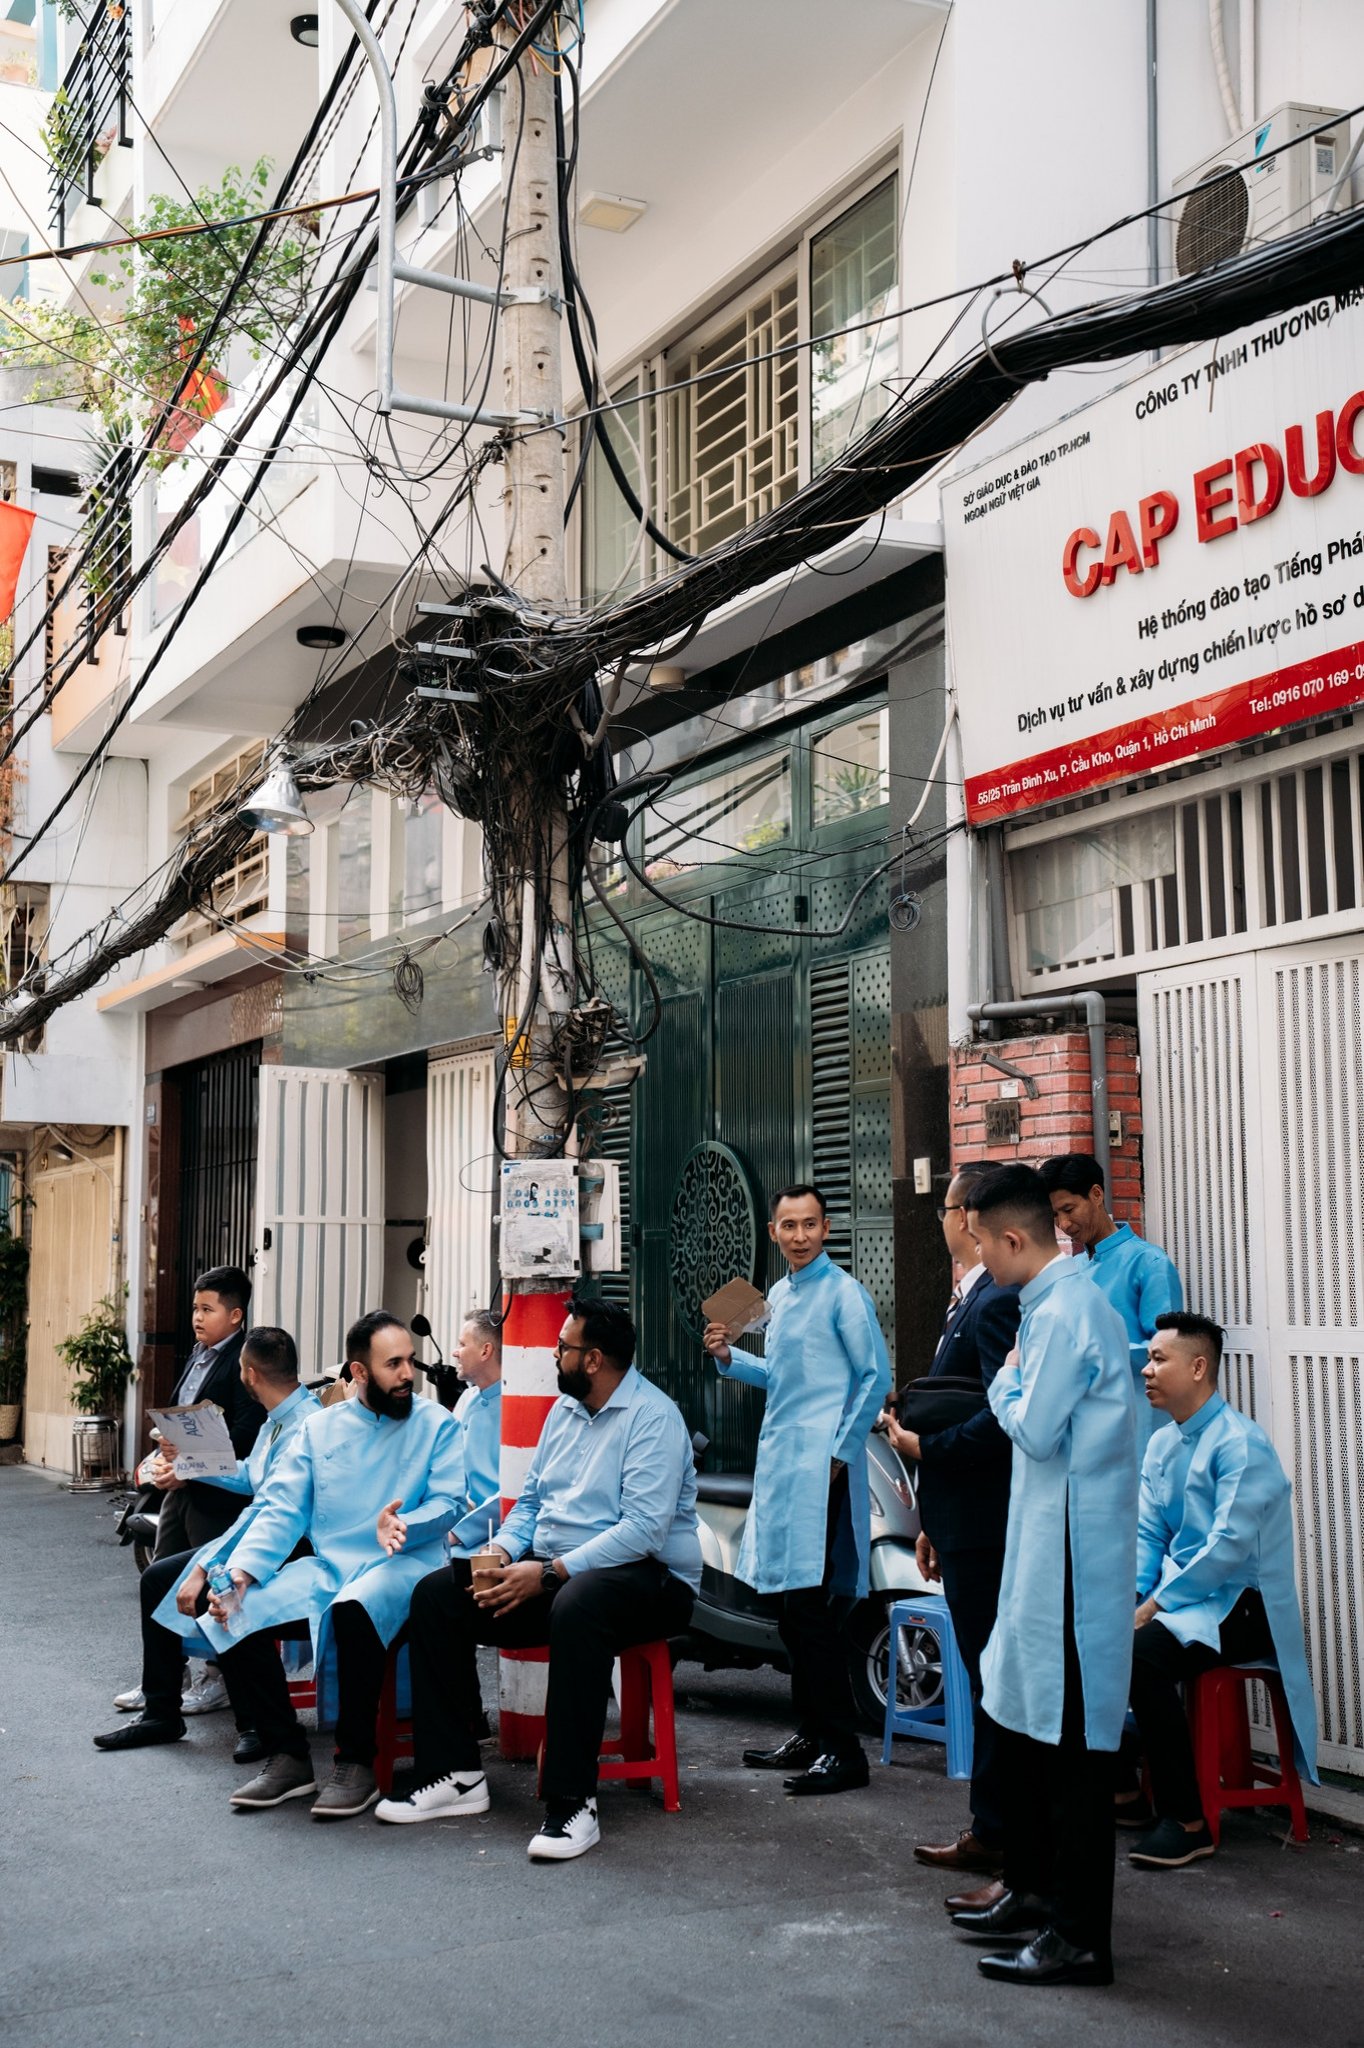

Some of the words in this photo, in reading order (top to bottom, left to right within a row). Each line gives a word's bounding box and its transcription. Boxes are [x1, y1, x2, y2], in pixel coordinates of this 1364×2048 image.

[1136, 383, 1178, 420] CÔNG
[1181, 369, 1201, 394] TY
[1204, 344, 1247, 382] TNHH
[1251, 300, 1330, 357] THƯƠNG
[964, 503, 988, 524] NGOẠI
[1008, 483, 1025, 501] VIỆT
[1026, 475, 1041, 491] GIA
[995, 472, 1012, 489] DỤC
[1014, 469, 1020, 480] &
[1021, 459, 1038, 477] ĐÀO
[1039, 450, 1056, 467] TẠO
[1058, 431, 1091, 458] TP.HCM
[1062, 490, 1180, 597] CAP
[1193, 389, 1364, 543] EDUC
[1138, 615, 1158, 639] Hệ
[1161, 598, 1206, 630] thống
[1210, 586, 1240, 610] đào
[1244, 573, 1271, 600] tạo
[1274, 551, 1322, 584] Tiếng
[1327, 531, 1364, 565] Phá
[1017, 707, 1046, 733] Dịch
[1049, 702, 1065, 721] vụ
[1068, 694, 1084, 713] tư
[1088, 681, 1113, 706] vấn
[1116, 676, 1127, 696] &
[1130, 668, 1155, 690] xây
[1158, 652, 1199, 682] dựng
[1203, 629, 1245, 663] chiến
[1248, 618, 1292, 646] lược
[1295, 602, 1318, 630] hồ
[1322, 593, 1347, 620] sơ
[977, 787, 1001, 805] 55/25
[1022, 773, 1042, 790] Đình
[1043, 769, 1059, 783] Xu,
[1060, 764, 1070, 778] P.
[1091, 750, 1114, 767] Kho,
[1115, 739, 1141, 759] Quận
[1142, 736, 1151, 752] 1,
[1153, 727, 1169, 746] Hồ
[1170, 722, 1188, 741] Chí
[1302, 677, 1324, 697] 070
